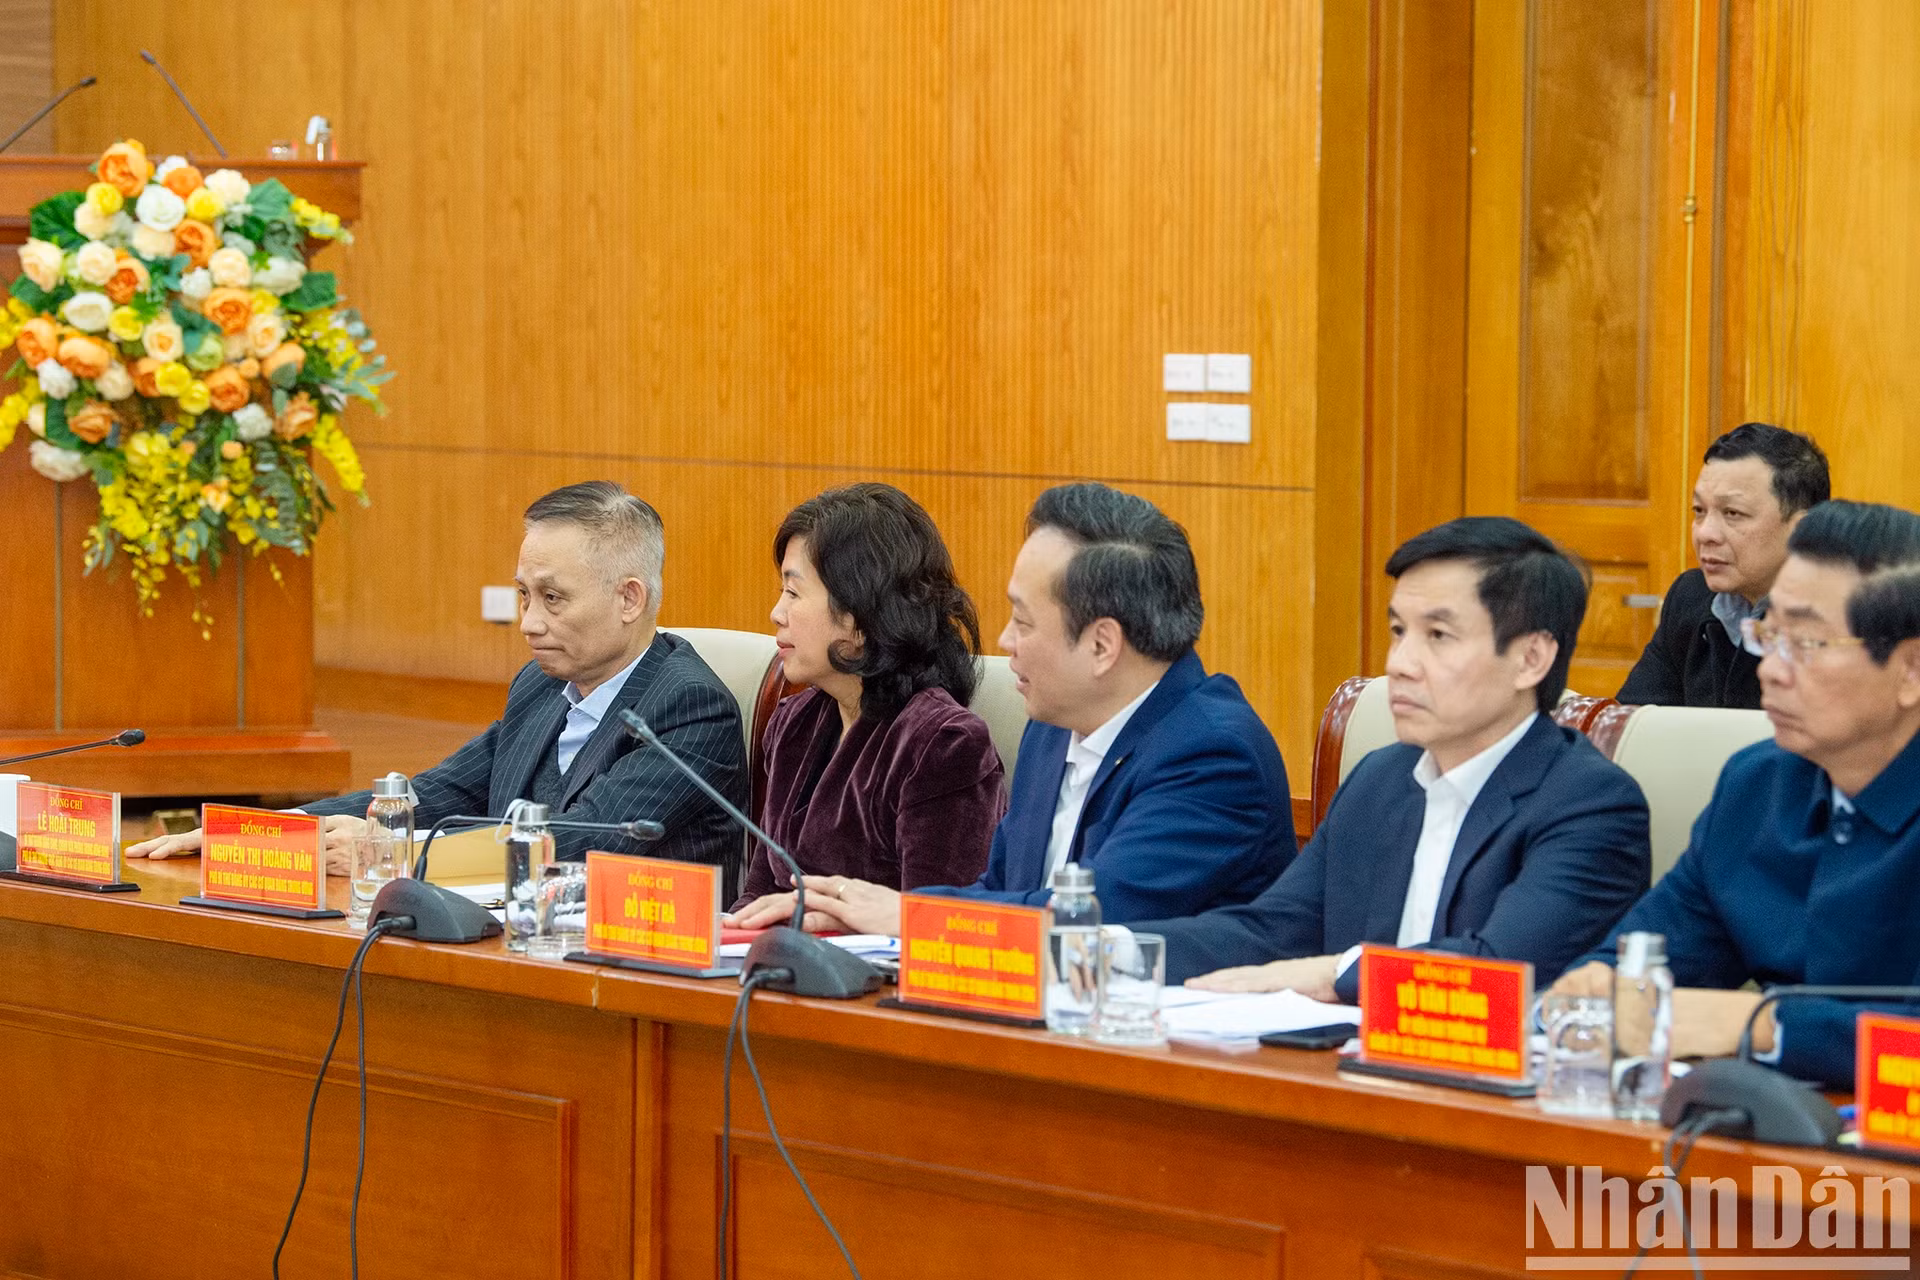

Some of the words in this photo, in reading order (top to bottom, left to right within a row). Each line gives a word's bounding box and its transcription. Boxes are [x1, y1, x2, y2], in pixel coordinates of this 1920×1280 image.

[38, 810, 47, 831] LÊ
[69, 817, 96, 838] TRUNG
[210, 839, 245, 864] NGUYỄN
[247, 847, 260, 870] THỊ
[262, 847, 292, 870] HOÀNG
[294, 849, 312, 872] VÂN
